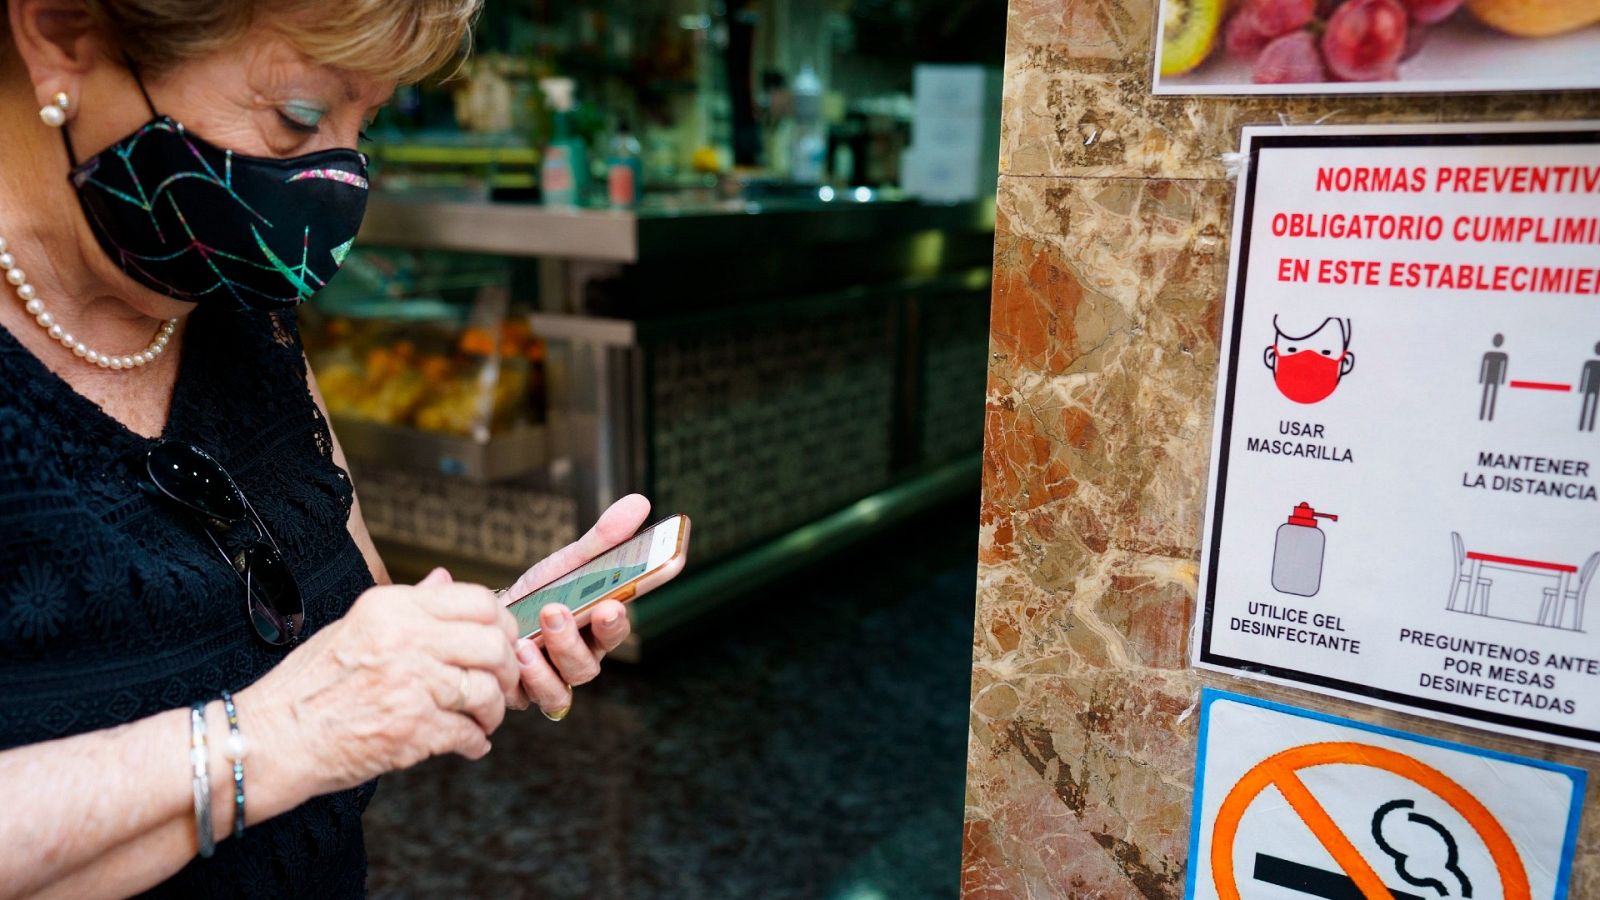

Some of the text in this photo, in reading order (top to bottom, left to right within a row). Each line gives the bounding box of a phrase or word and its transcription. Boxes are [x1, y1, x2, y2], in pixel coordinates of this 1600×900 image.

[1315, 166, 1600, 193] NORMAS PREVENTIV
[1271, 212, 1600, 244] OBLIGATORIO CUMPLIMI
[1277, 258, 1310, 283] EN
[1317, 260, 1381, 285] ESTE
[1279, 420, 1325, 439] USAR
[1247, 437, 1354, 463] MASCARILLA
[1477, 452, 1590, 477] MANTENER
[1462, 472, 1598, 502] LA DISTANCIA
[1248, 601, 1346, 632] UTILICE GEL
[1230, 617, 1361, 655] DESINFECTANTE
[1400, 628, 1600, 677] PREGUNTENOS ANTE
[1443, 656, 1556, 690] POR MESAS
[1419, 672, 1576, 715] DESINFECTADAS
